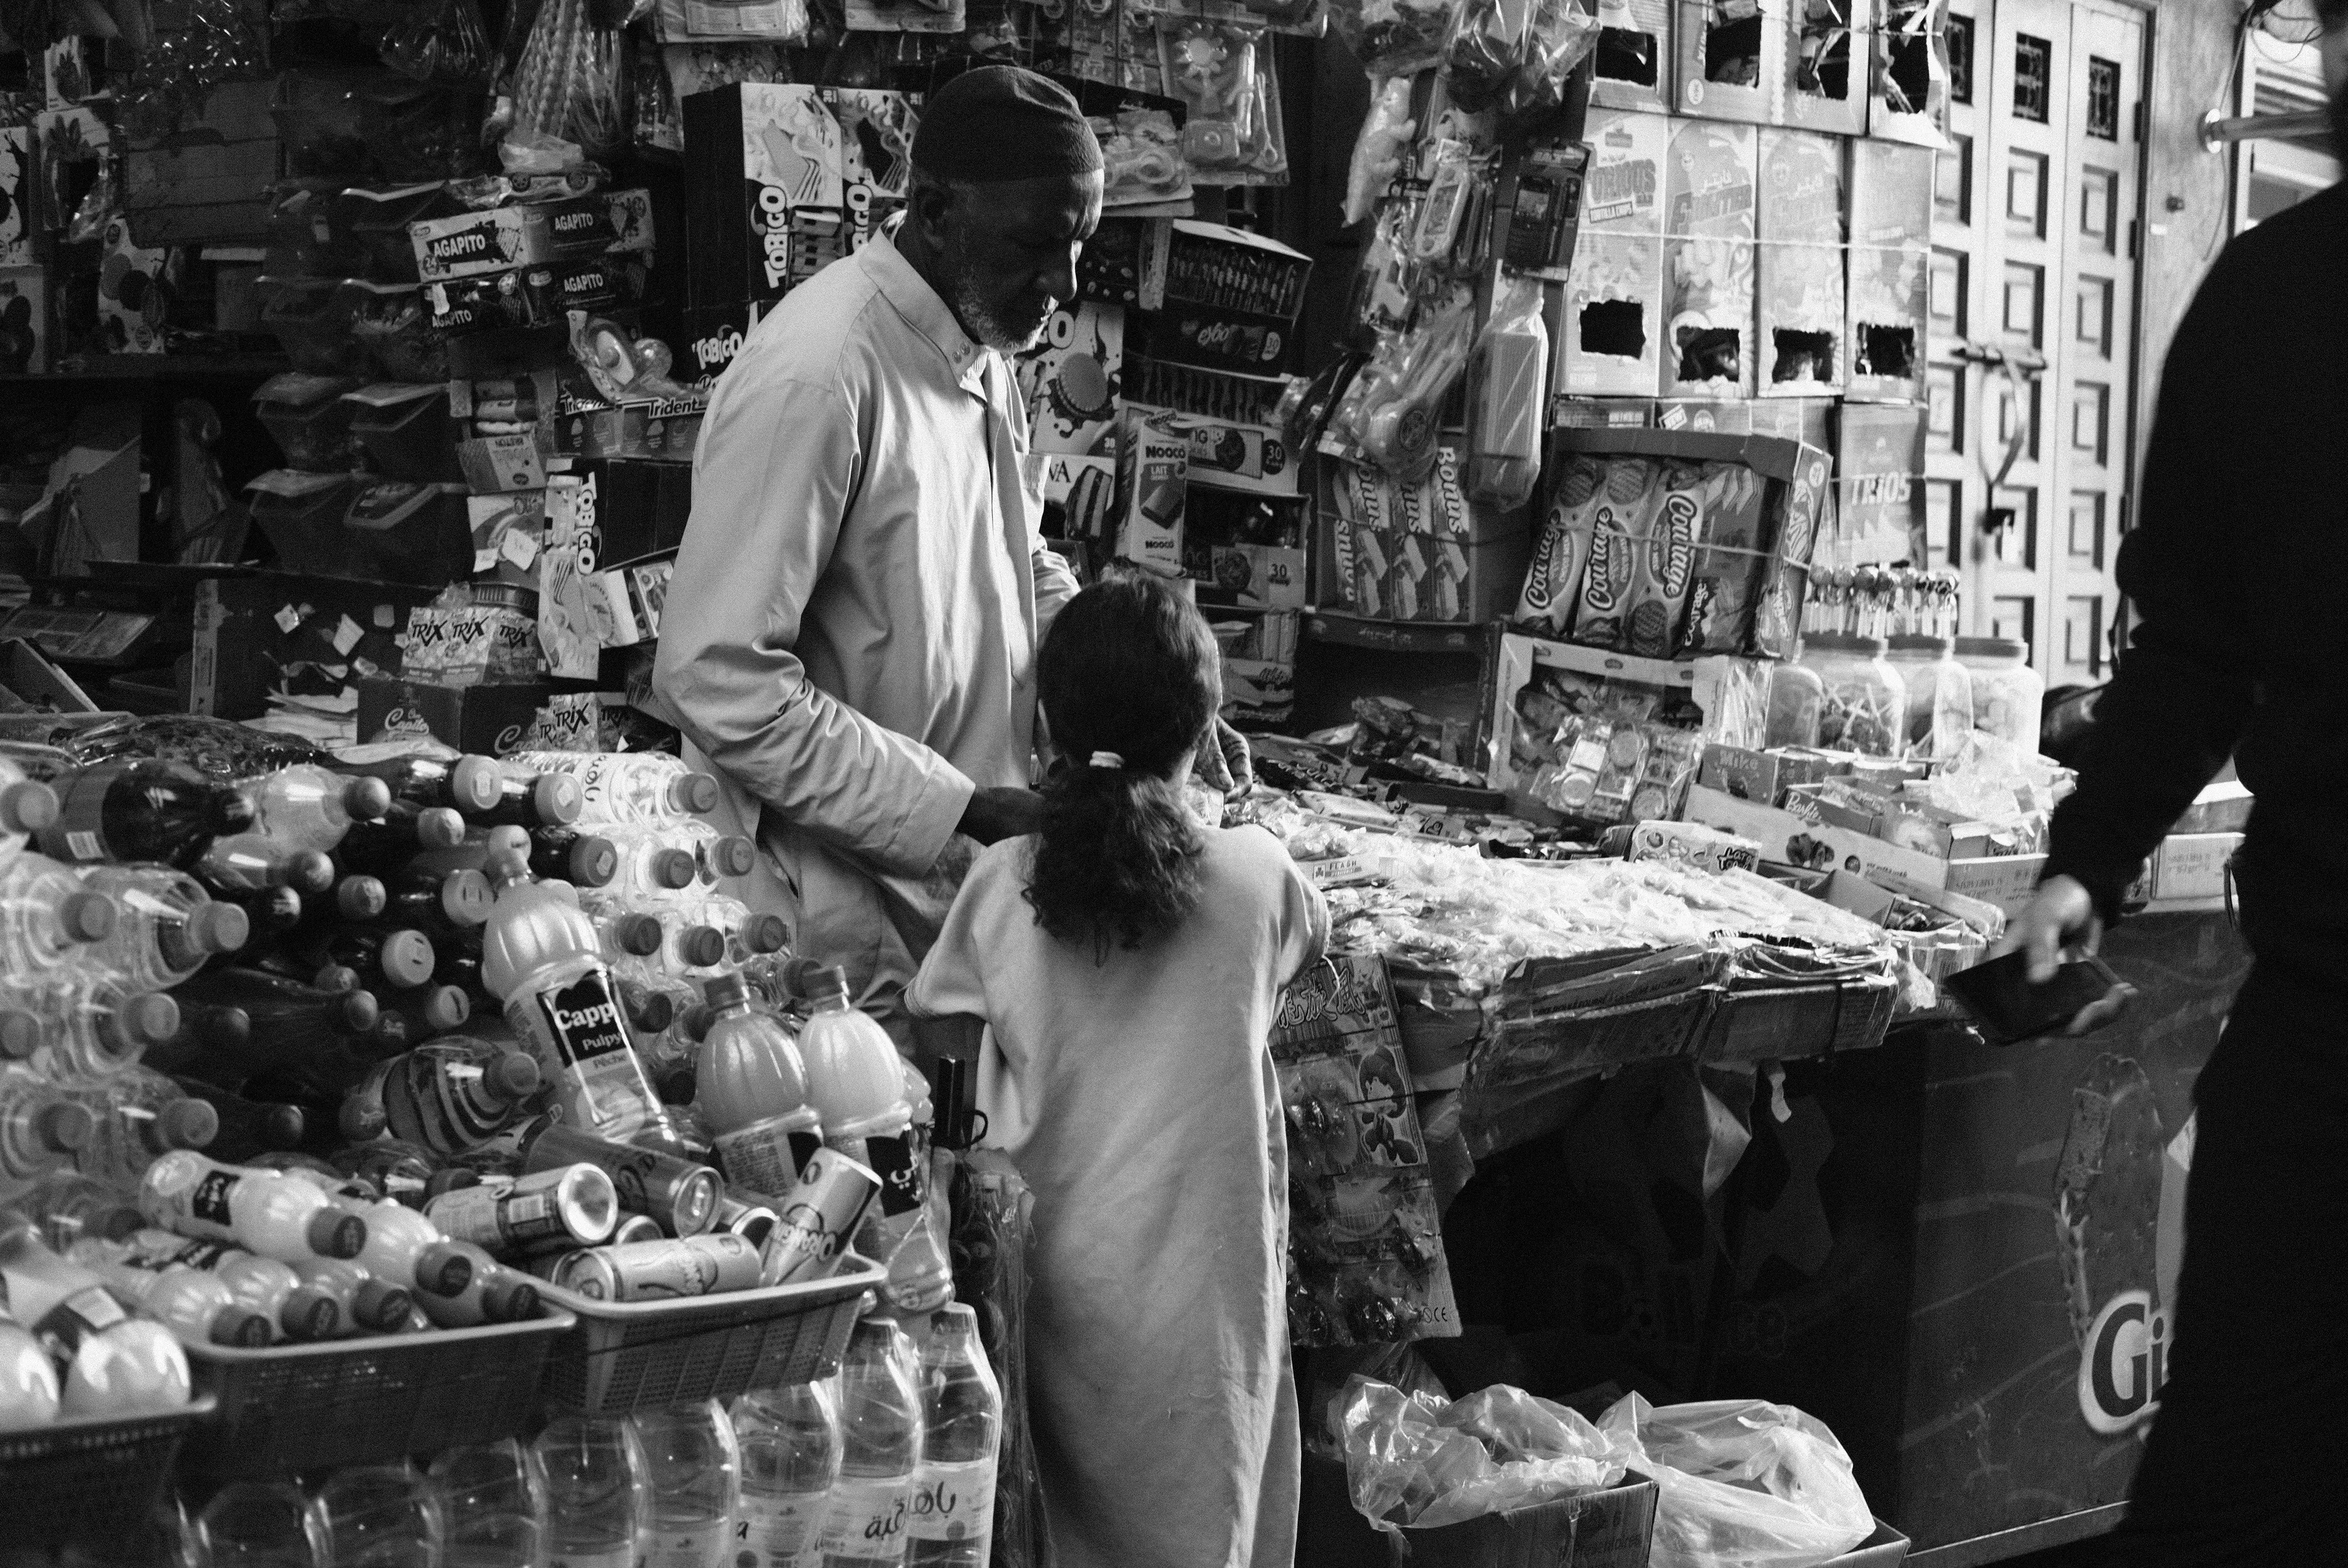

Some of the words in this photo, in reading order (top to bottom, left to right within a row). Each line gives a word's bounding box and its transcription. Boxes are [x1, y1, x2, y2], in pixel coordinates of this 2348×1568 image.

[555, 213, 594, 231] AGAPITO
[759, 186, 787, 289] TOBIGO
[846, 183, 872, 254] BIGO
[434, 234, 486, 258] AGAPITO
[564, 273, 604, 293] AGAPITO
[690, 330, 743, 371] TOBIGO
[646, 396, 699, 417] Trident
[1049, 461, 1071, 484] VA
[1266, 445, 1283, 461] 30
[1358, 467, 1384, 533] onus
[1437, 446, 1462, 533] Bonus
[577, 470, 597, 575] TOBIGO
[1526, 508, 1561, 609] Courage
[1586, 506, 1614, 611] Courage
[1665, 495, 1696, 599] Courage
[1271, 563, 1287, 578] 30
[1329, 861, 1357, 870] FLASH
[555, 1002, 616, 1030] Capp
[2082, 1294, 2167, 1428] Gi
